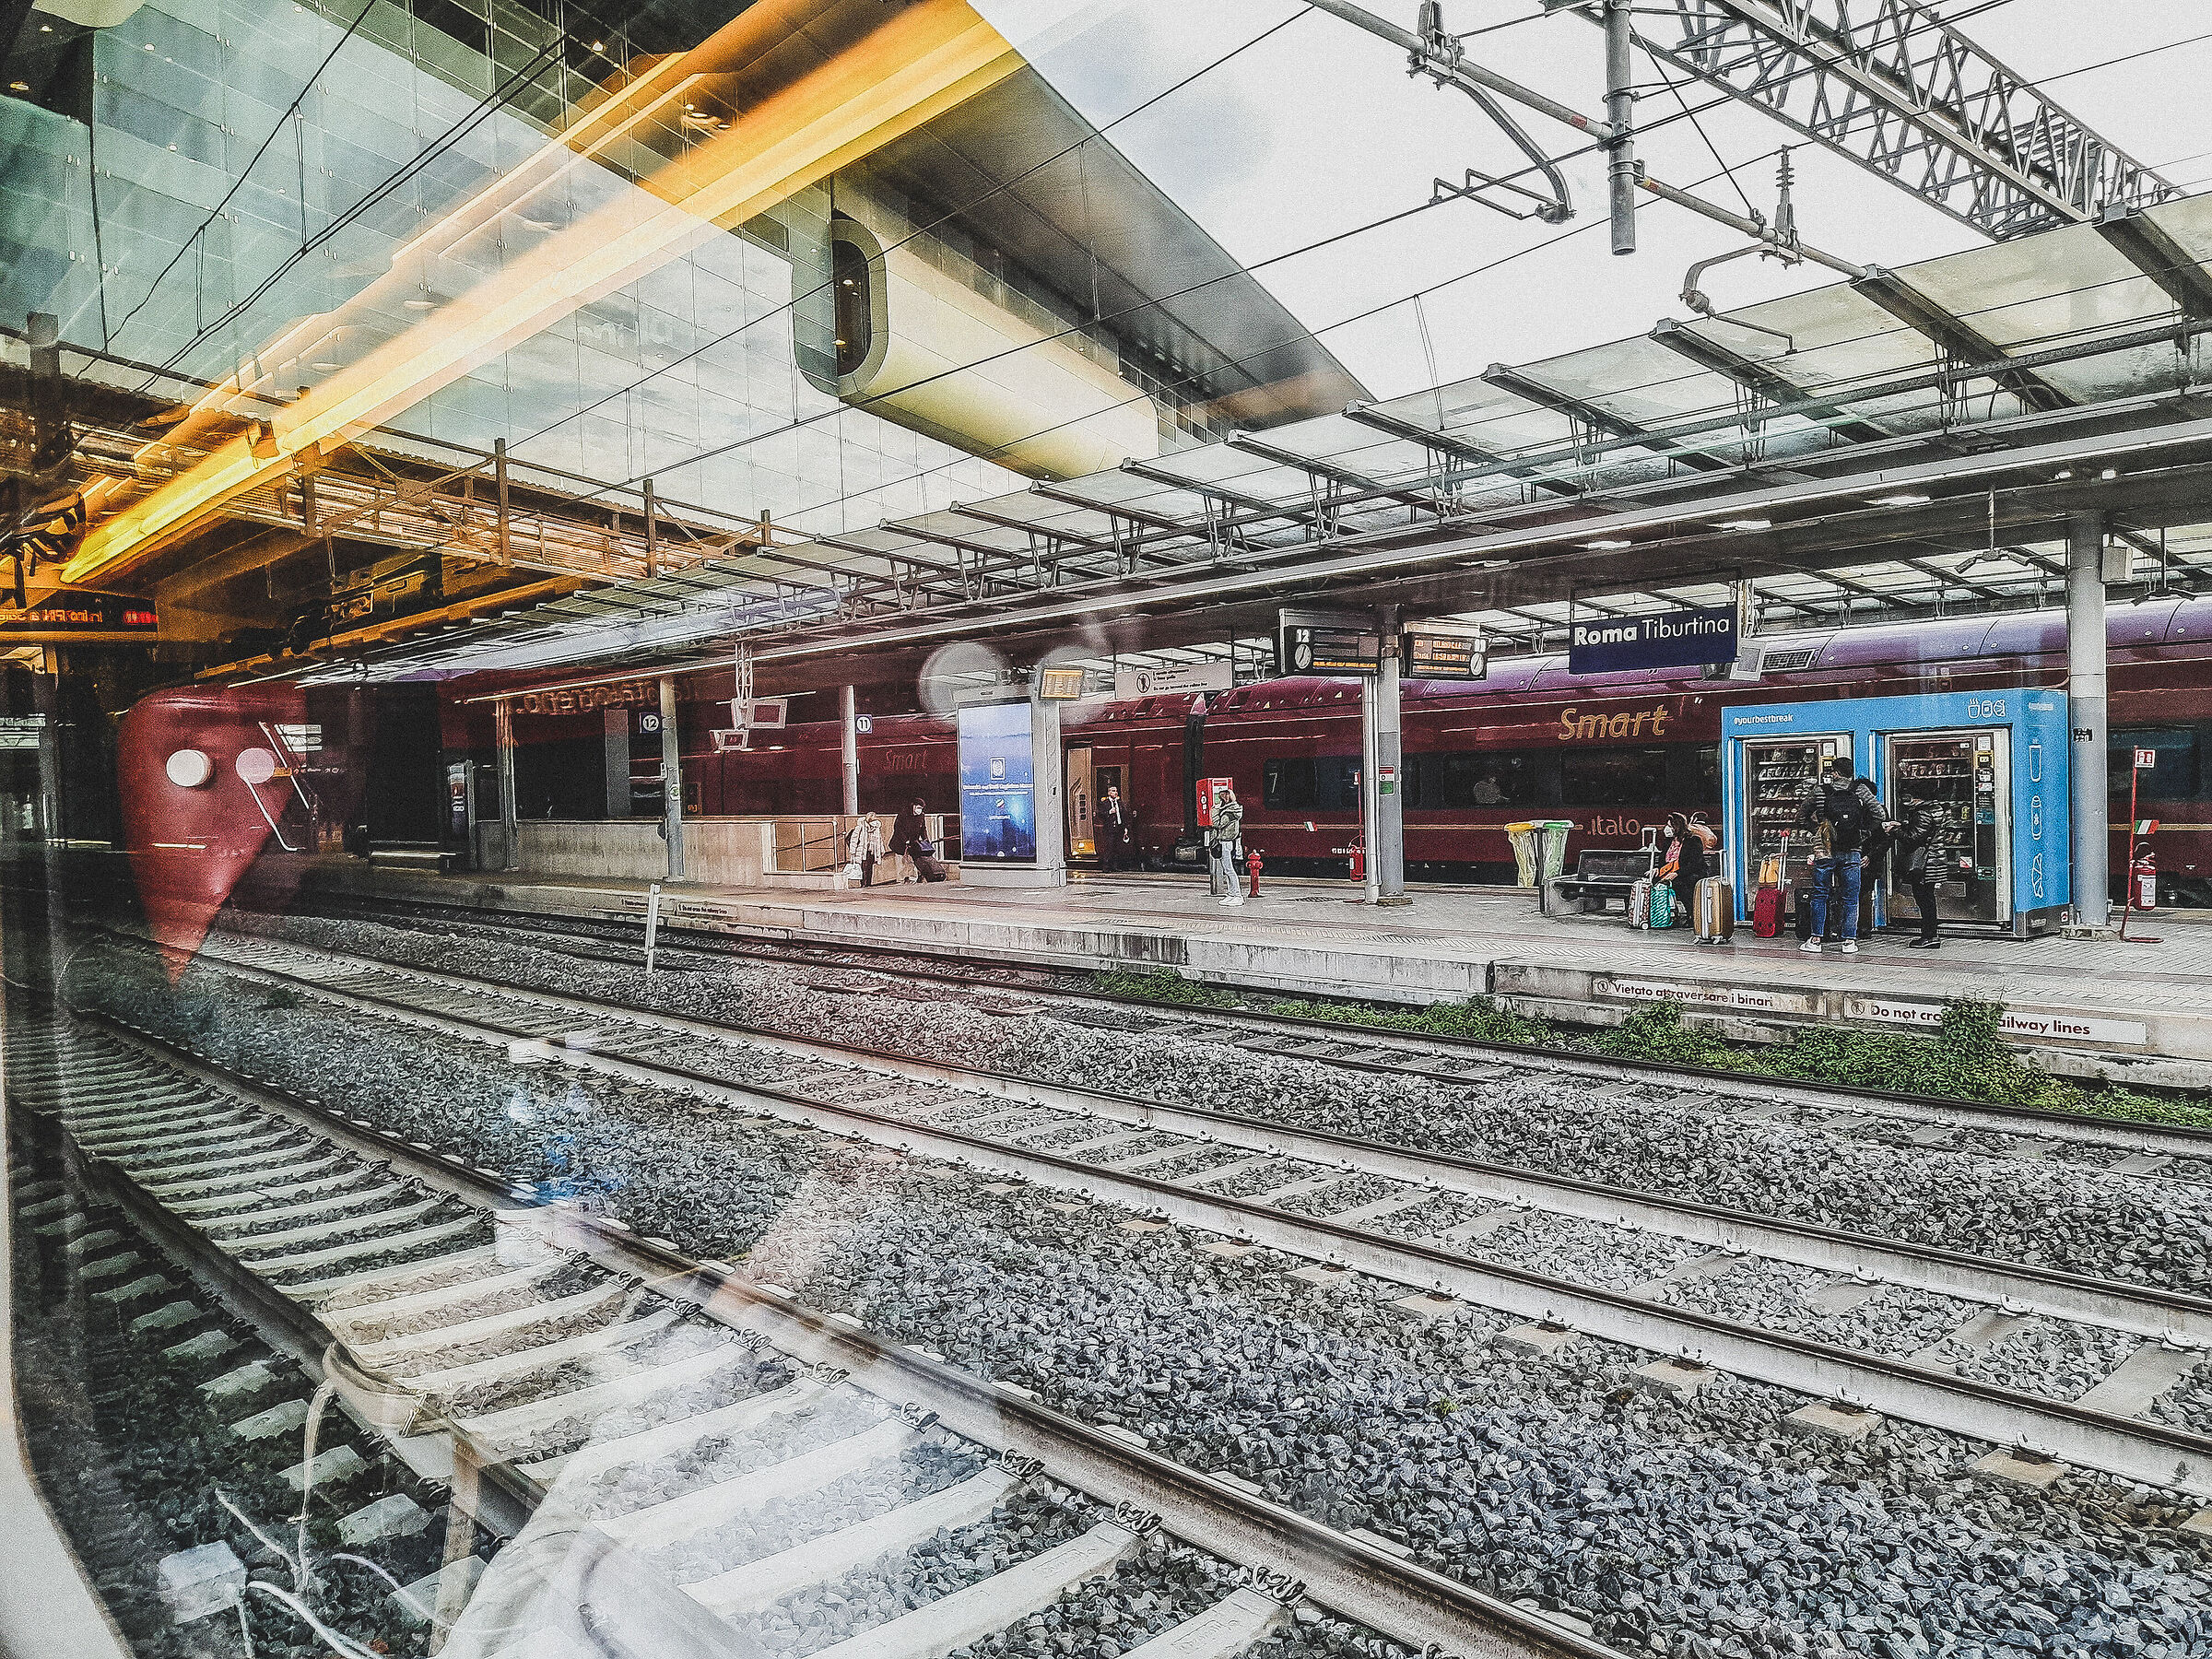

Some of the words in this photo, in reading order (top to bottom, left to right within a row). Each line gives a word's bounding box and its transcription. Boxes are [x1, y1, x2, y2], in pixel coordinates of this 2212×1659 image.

[1295, 629, 1310, 643] 12
[1574, 626, 1638, 646] Roma
[1641, 616, 1730, 640] Tiburtina
[644, 718, 657, 728] 12
[858, 719, 868, 729] 11
[1559, 704, 1668, 740] Smart
[1734, 712, 1794, 726] #yourbestbreak
[1268, 772, 1278, 794] 7
[1614, 982, 1653, 996] Vietato
[1737, 993, 1773, 1006] binari
[1871, 1005, 1889, 1018] Do
[1893, 1009, 1917, 1019] not
[1997, 1016, 2049, 1033] ailway
[2053, 1019, 2090, 1034] lines
